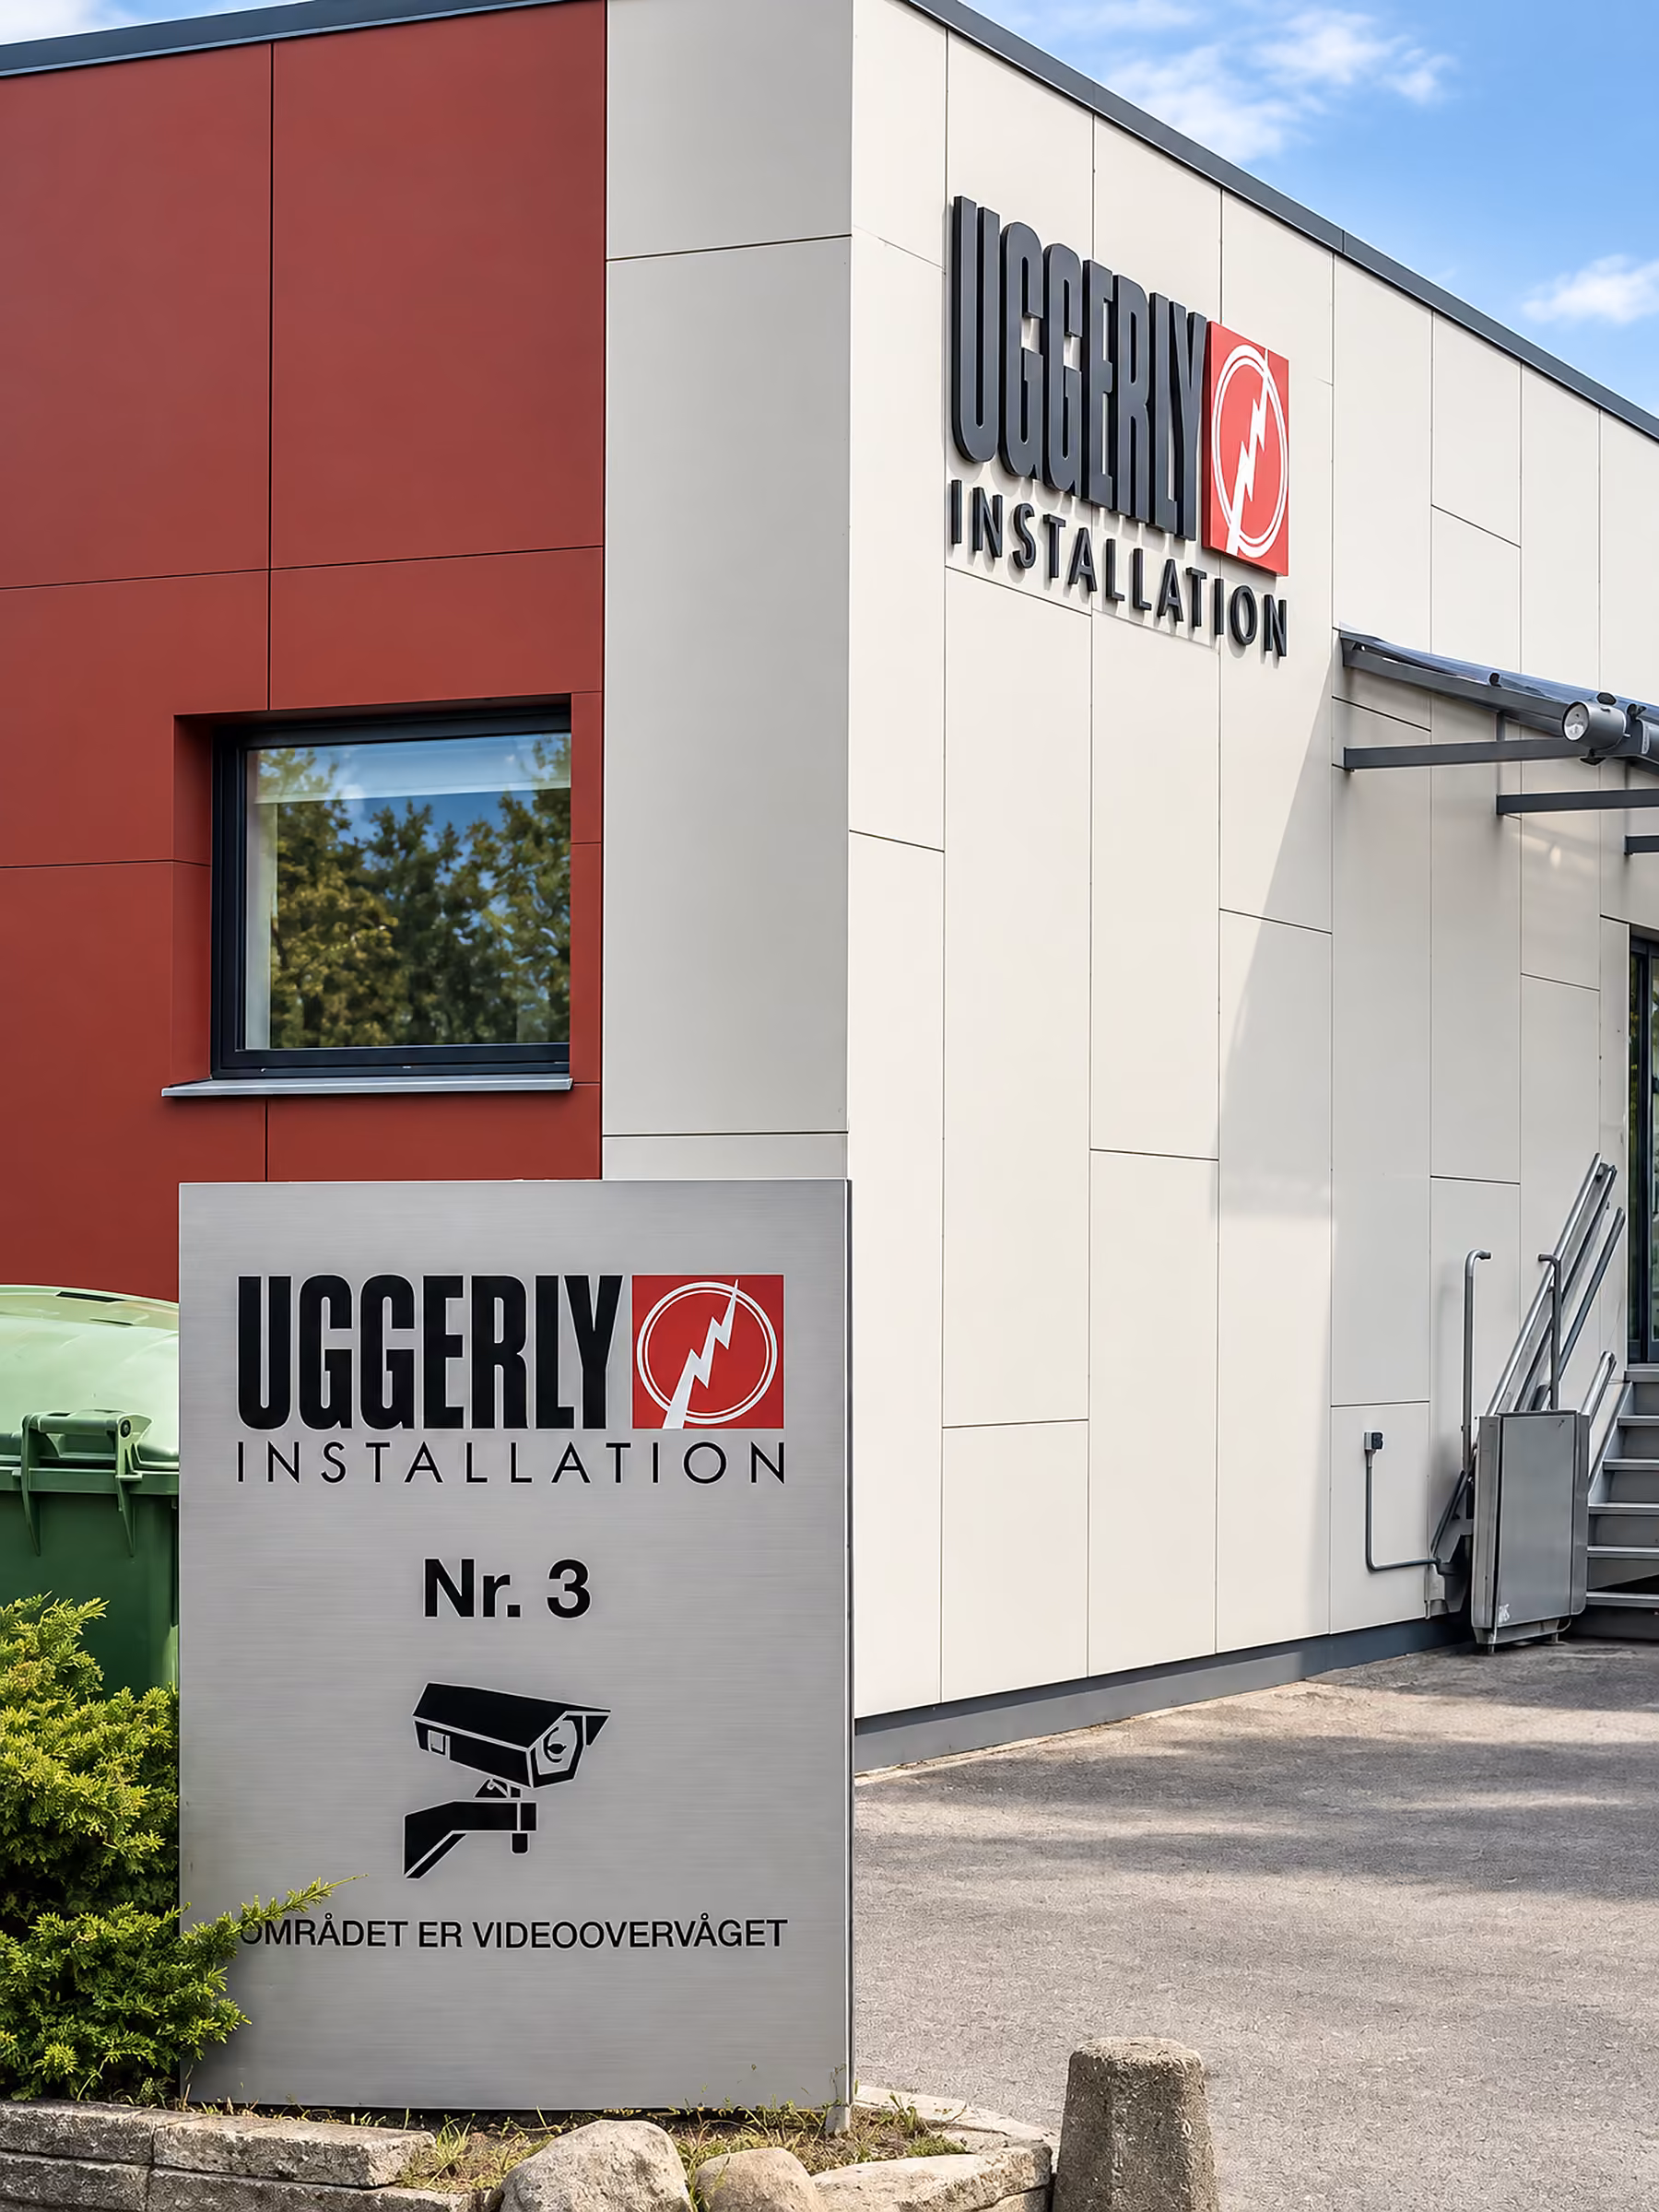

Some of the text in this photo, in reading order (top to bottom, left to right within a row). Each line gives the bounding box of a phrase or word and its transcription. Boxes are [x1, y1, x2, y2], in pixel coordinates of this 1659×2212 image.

[952, 195, 1206, 541] UGGERLY
[951, 479, 1288, 657] INSTALLATION
[237, 1274, 623, 1430] UGGERLY
[237, 1441, 785, 1484] INSTALLATION
[424, 1558, 591, 1618] Nr. 3
[240, 1912, 789, 1949] OMRÅDET ER VIDEOOVERVÅGET
